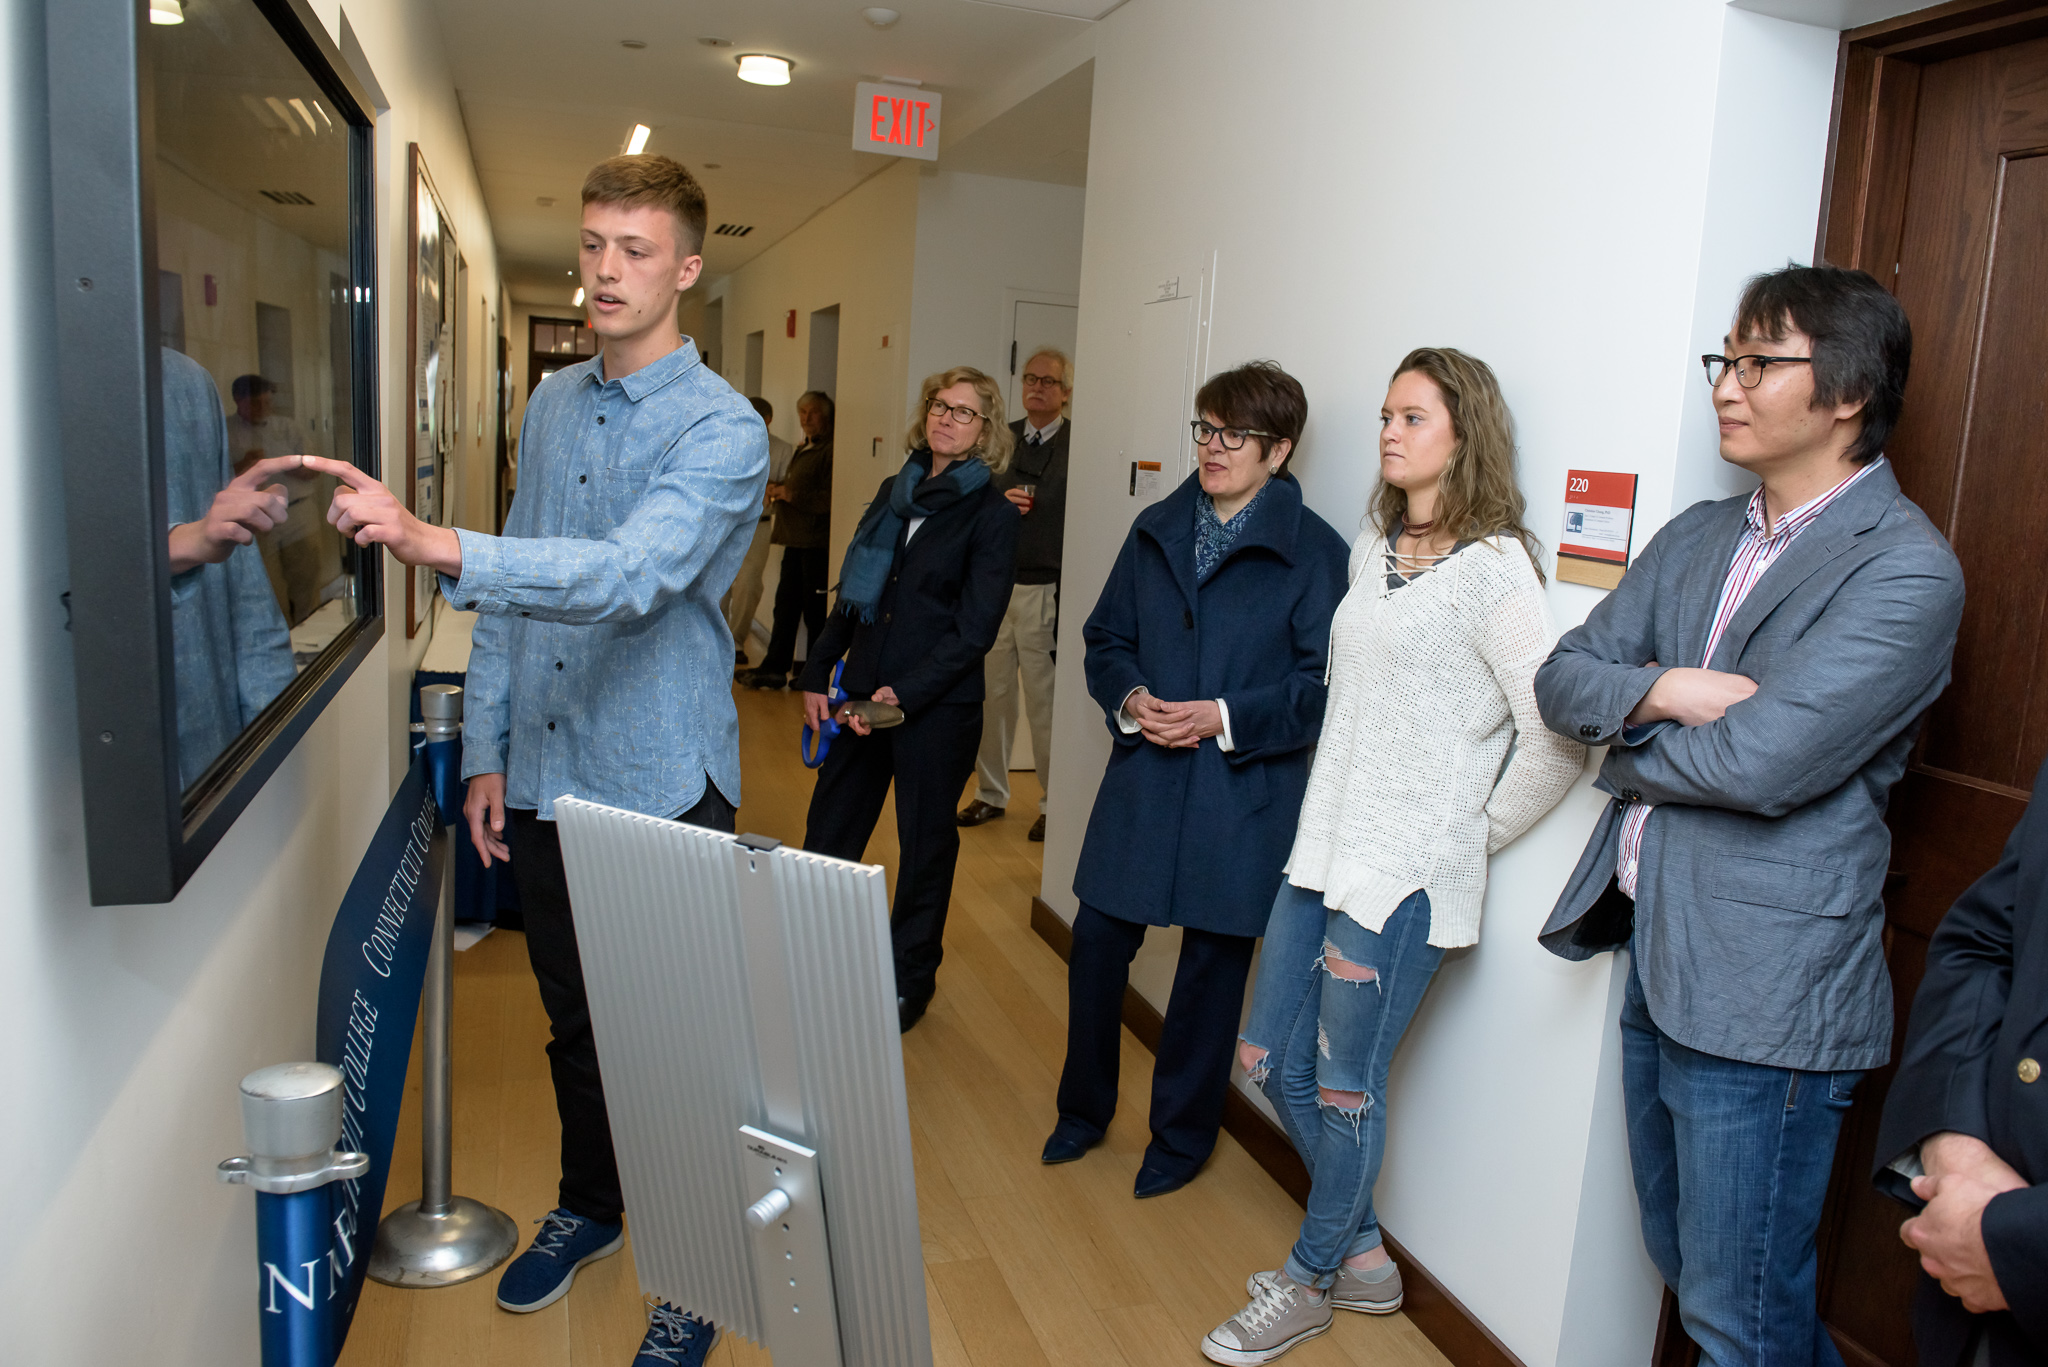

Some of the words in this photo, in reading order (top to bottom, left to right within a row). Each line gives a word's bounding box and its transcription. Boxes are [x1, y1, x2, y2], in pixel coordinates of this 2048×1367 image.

[870, 94, 931, 148] EXIT
[1569, 477, 1589, 493] 220
[362, 839, 424, 978] CONNECTICUT
[339, 988, 379, 1113] COLLEGE
